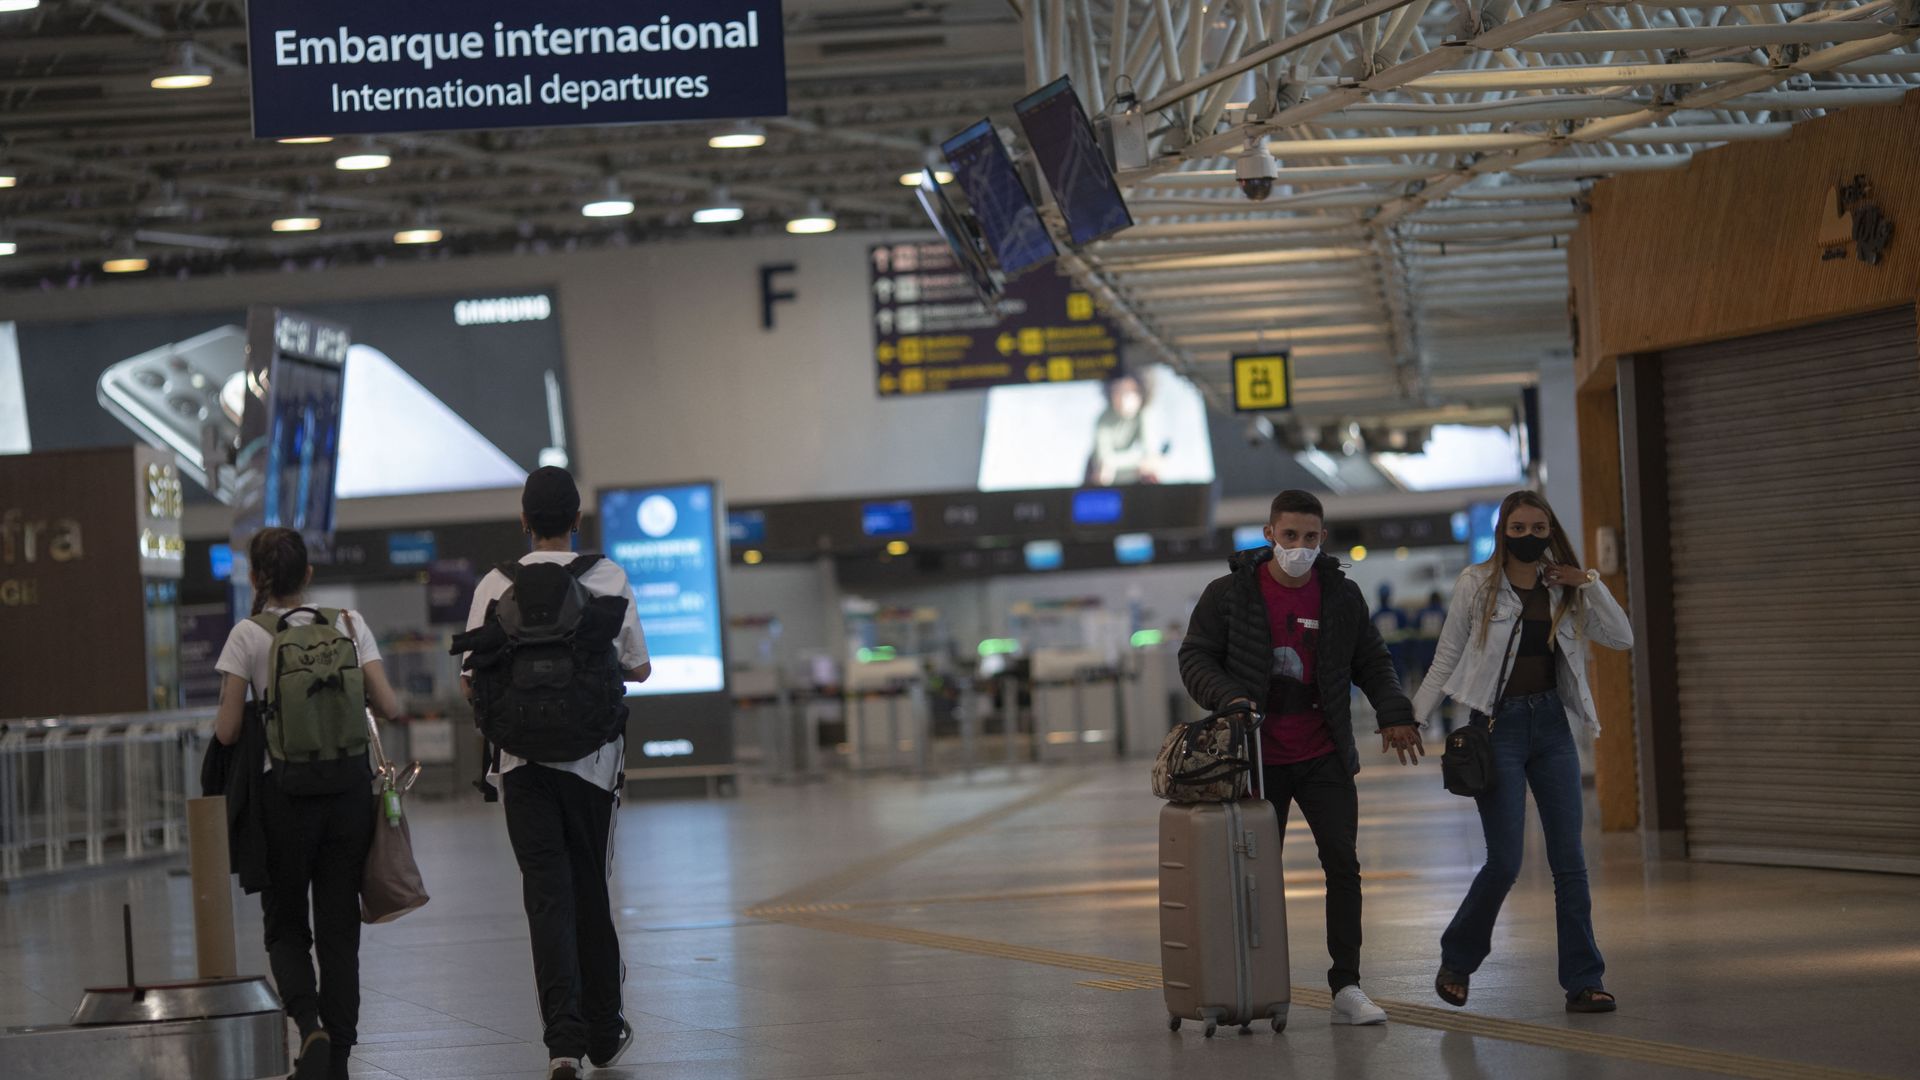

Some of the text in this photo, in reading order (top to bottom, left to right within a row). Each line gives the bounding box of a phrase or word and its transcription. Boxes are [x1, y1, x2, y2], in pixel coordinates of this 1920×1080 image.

[275, 10, 759, 70] Embarque internacional
[332, 73, 709, 113] International departures
[758, 263, 797, 330] F
